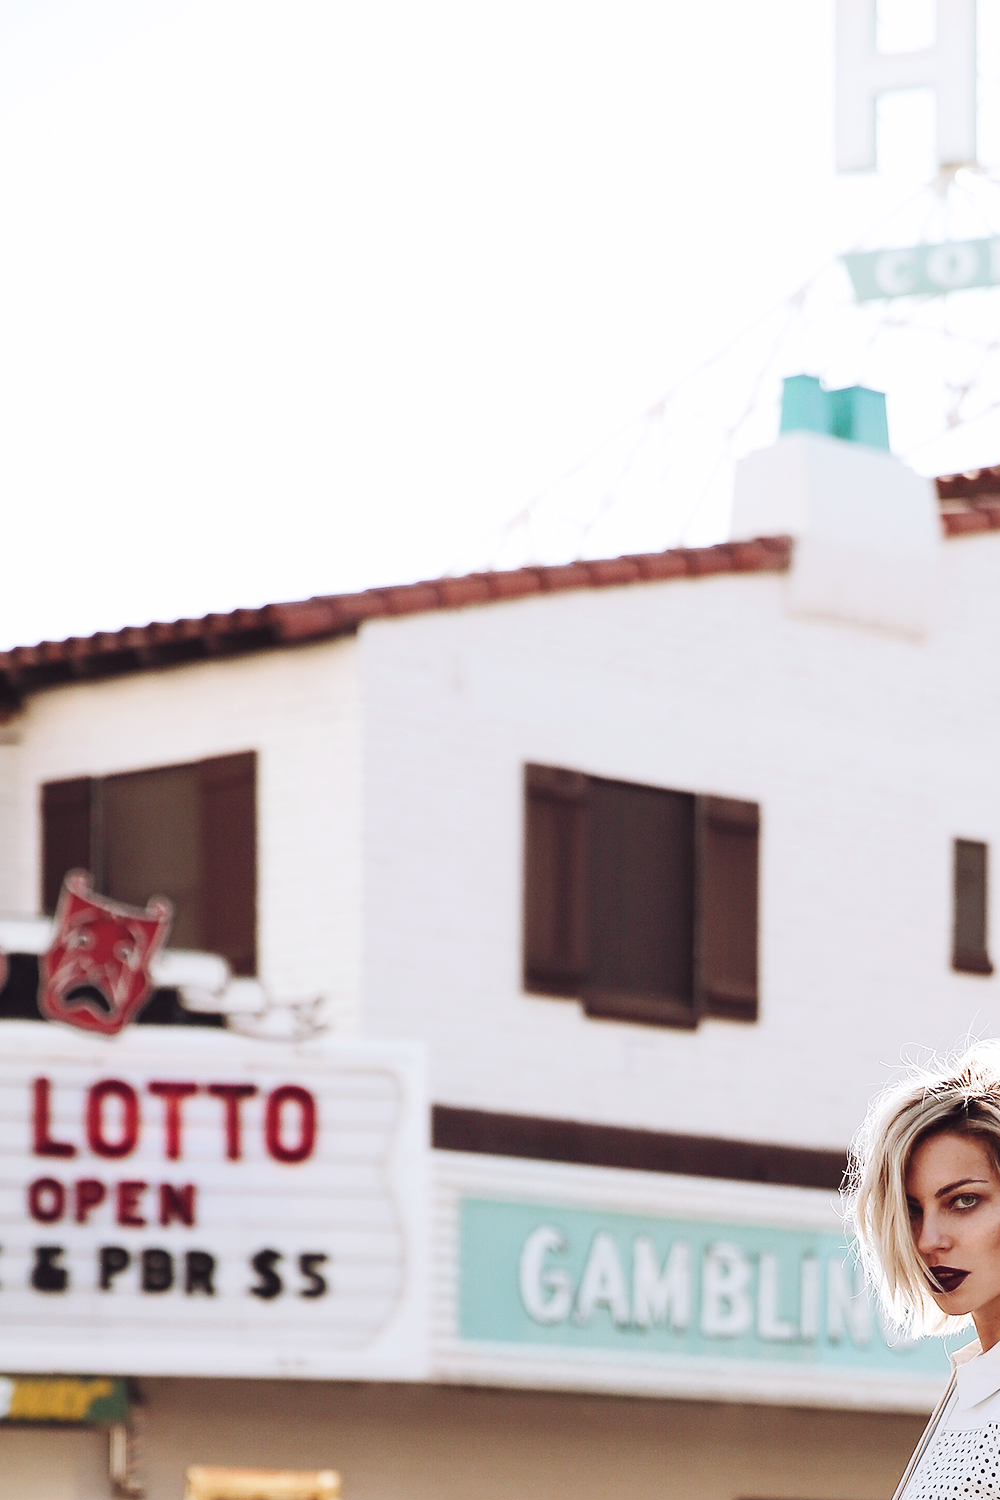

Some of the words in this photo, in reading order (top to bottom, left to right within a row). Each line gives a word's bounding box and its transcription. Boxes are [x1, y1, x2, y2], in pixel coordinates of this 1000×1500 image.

[32, 1077, 317, 1164] LOTTO
[28, 1177, 196, 1227] OPEN
[31, 1246, 69, 1293] &
[99, 1246, 217, 1296] PBR
[250, 1248, 328, 1299] $5
[519, 1224, 920, 1352] GAMBLIN
